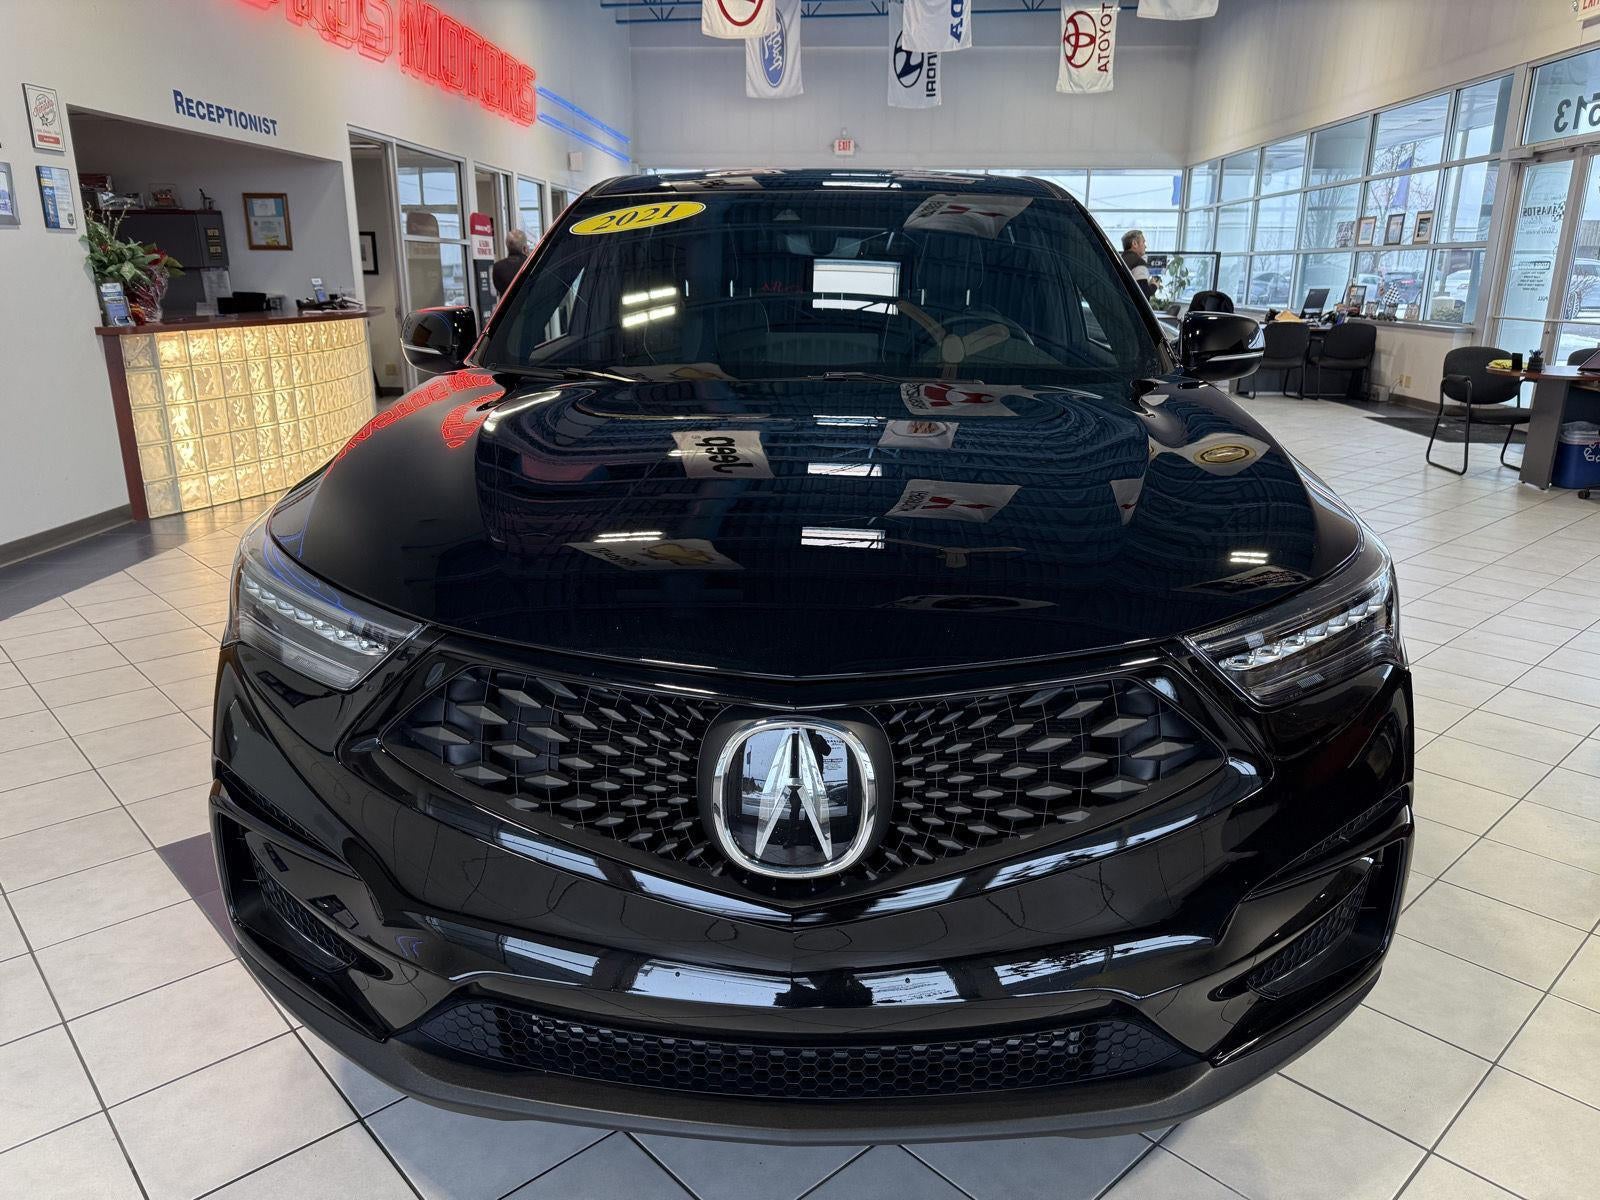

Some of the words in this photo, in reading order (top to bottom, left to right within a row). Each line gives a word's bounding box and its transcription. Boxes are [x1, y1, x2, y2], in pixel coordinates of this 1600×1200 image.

[400, 0, 537, 126] MOTORS
[173, 89, 277, 136] RECEPTIONIST
[838, 140, 851, 151] EXIT
[591, 204, 679, 231] 2021
